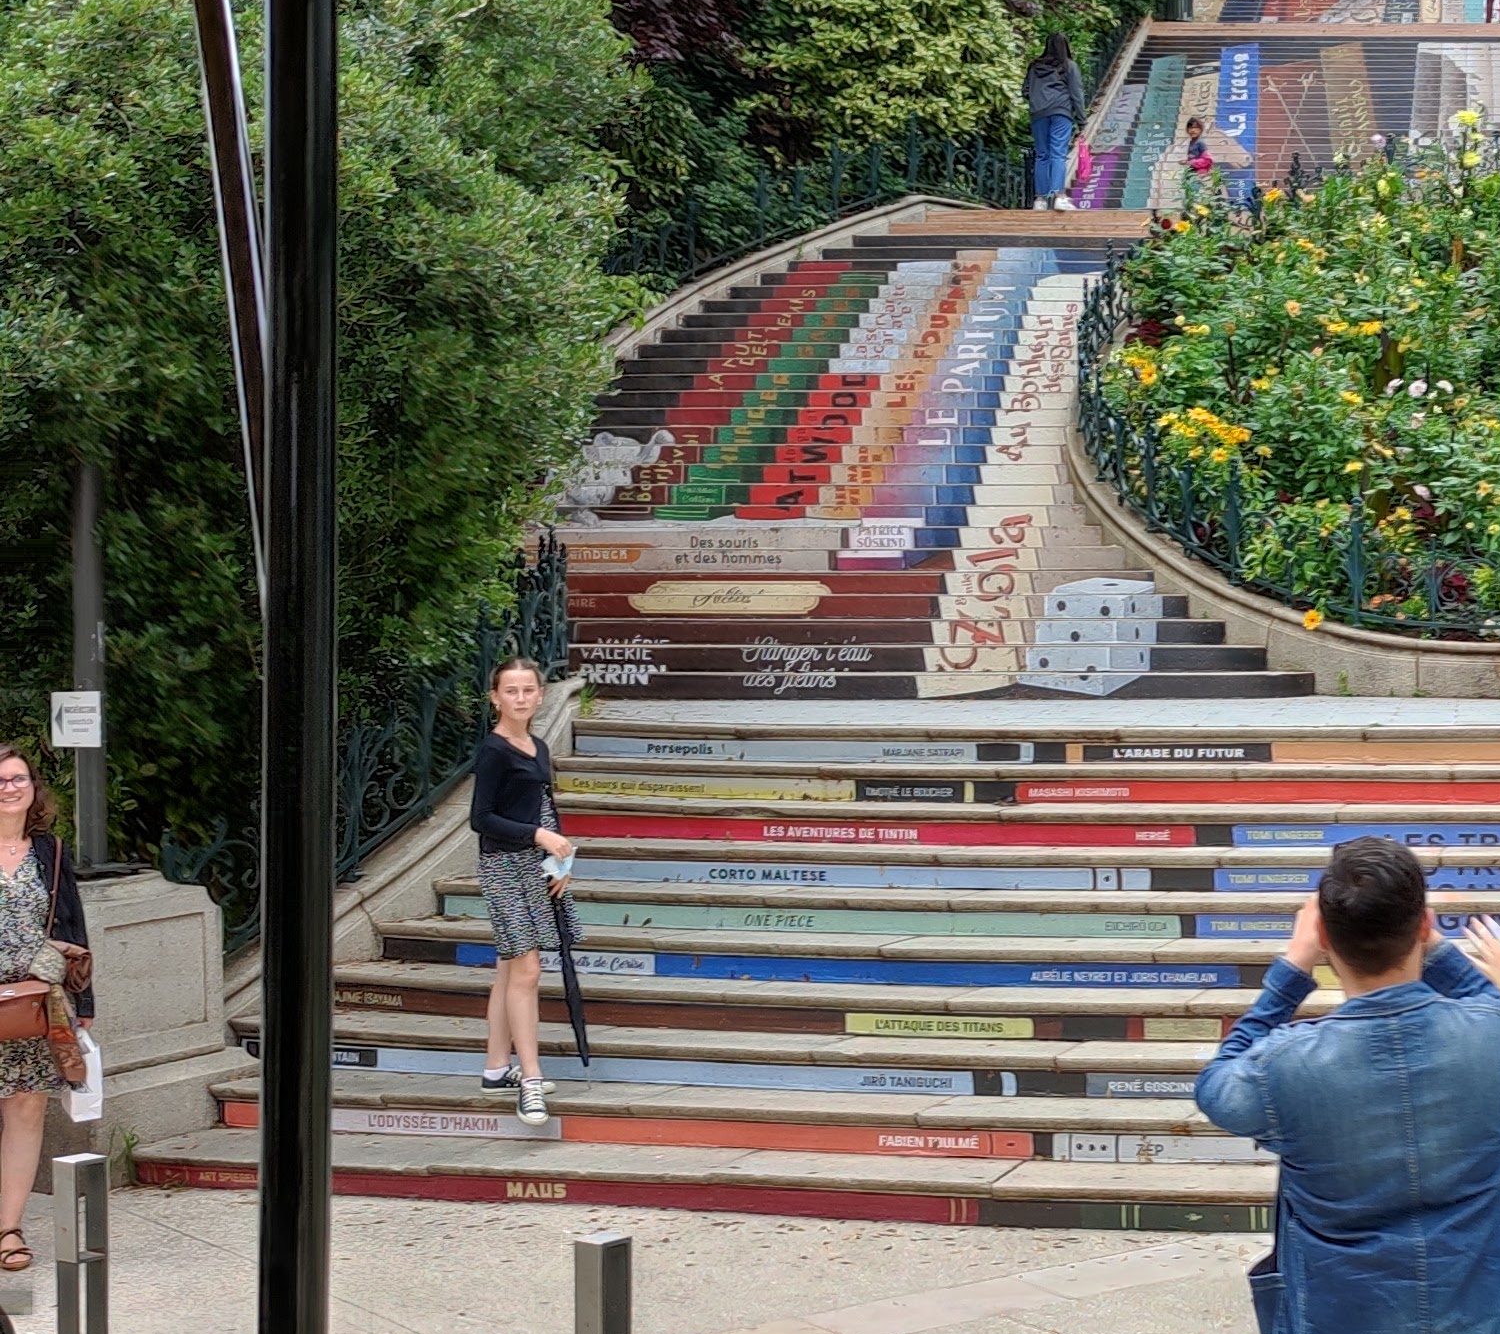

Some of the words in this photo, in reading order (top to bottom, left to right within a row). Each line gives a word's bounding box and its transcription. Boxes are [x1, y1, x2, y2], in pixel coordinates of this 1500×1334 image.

[918, 407, 959, 446] LE
[775, 375, 867, 511] ATWOOD
[690, 535, 716, 549] Des
[718, 536, 759, 549] souris
[567, 548, 628, 561] einbeck
[675, 553, 690, 565] et
[693, 552, 717, 565] des
[720, 551, 783, 566] hommes
[646, 742, 714, 756] Persepolis
[1113, 747, 1172, 759] L'ARABE
[1173, 748, 1194, 759] DU
[1197, 748, 1246, 759] FUTUR
[572, 778, 590, 789] Ces
[591, 779, 619, 791] jours
[638, 780, 705, 795] disparaissent
[763, 825, 785, 837] LES
[785, 825, 857, 839] AVENTURES
[858, 827, 875, 839] DE
[877, 828, 919, 840] TINTIN
[708, 868, 757, 880] CORTO
[760, 869, 827, 881] MALTESE
[743, 914, 772, 928] ONE
[774, 914, 816, 929] PIECE
[875, 1019, 935, 1034] L'ATTAQUE
[936, 1020, 960, 1032] DES
[962, 1021, 1004, 1034] TITANS
[889, 1076, 953, 1089] TANIGUCHI
[1107, 1079, 1143, 1093] RENÉ
[1144, 1081, 1196, 1093] GOSCINN
[368, 1113, 437, 1130] L'ODYSSÉE
[440, 1116, 499, 1132] D'HAKIM
[878, 1134, 924, 1148] FABIEN
[506, 1182, 568, 1199] MAUS
